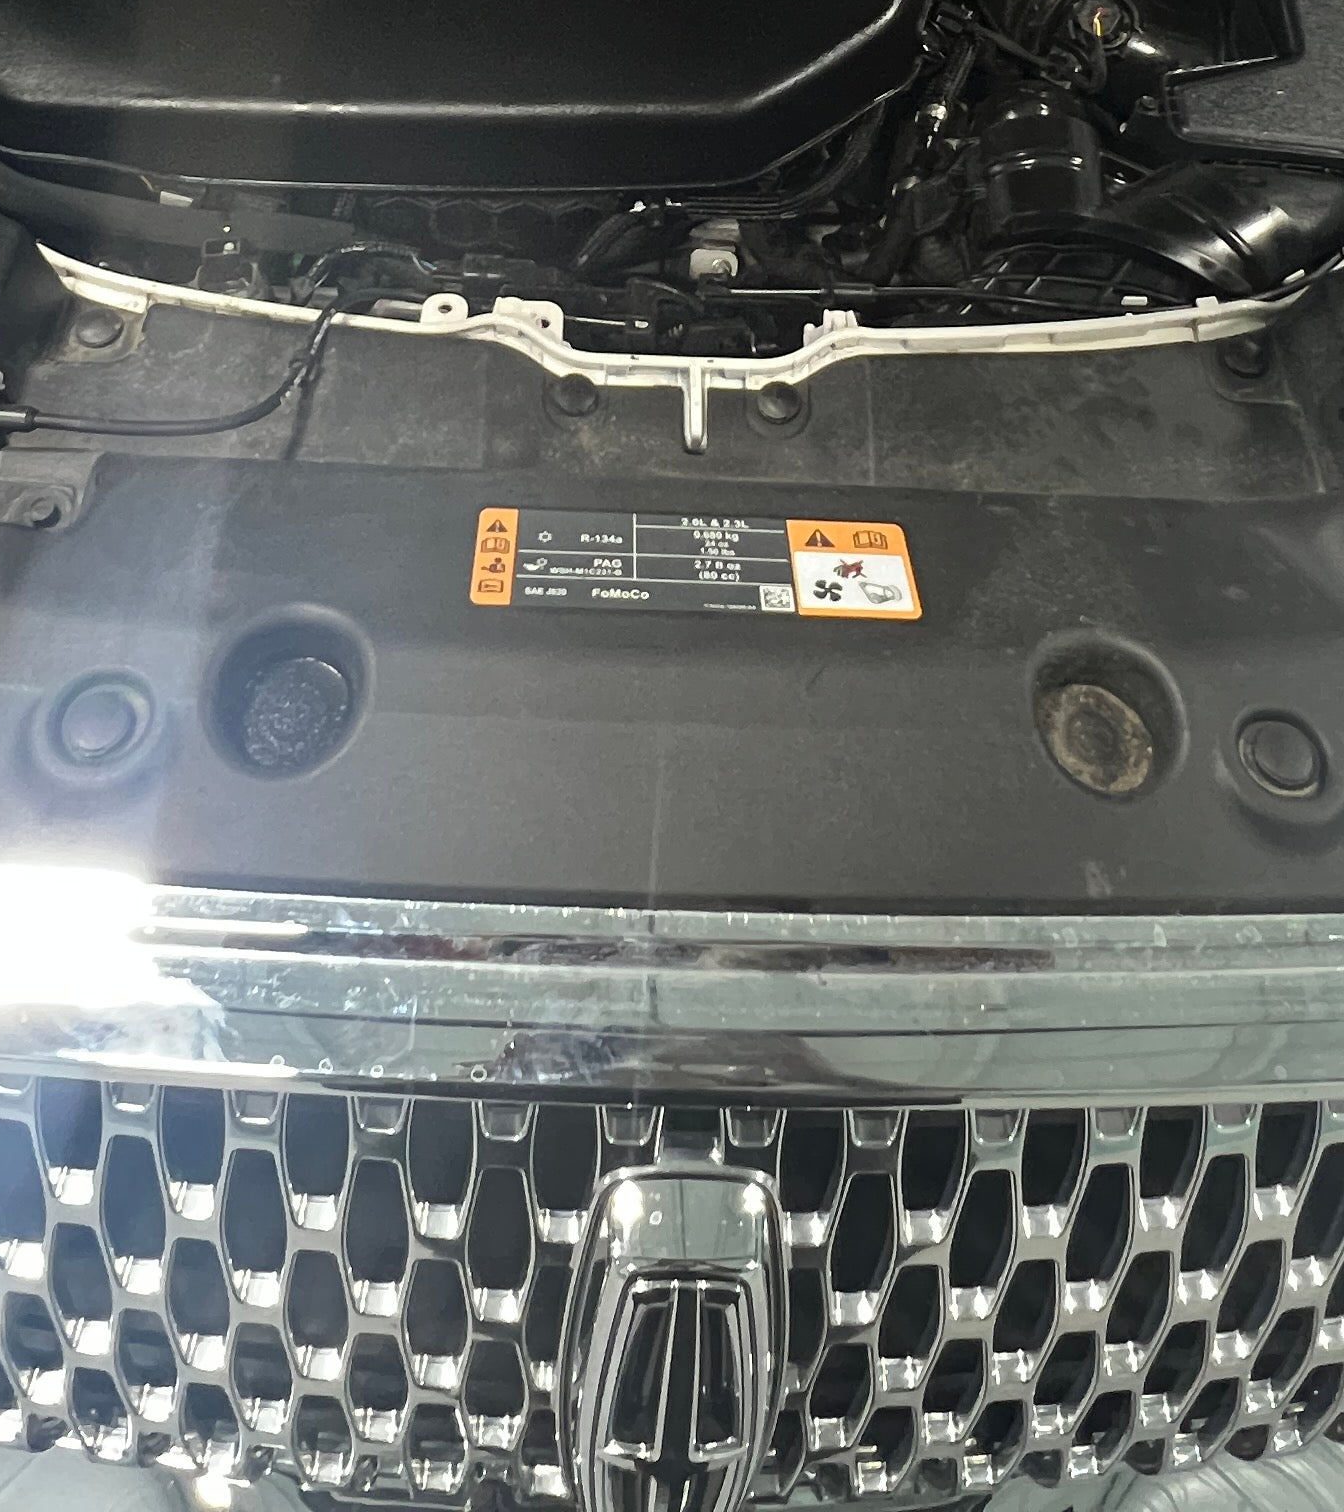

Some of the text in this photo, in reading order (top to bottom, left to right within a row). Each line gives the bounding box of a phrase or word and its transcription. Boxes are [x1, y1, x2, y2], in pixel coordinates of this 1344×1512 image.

[723, 519, 749, 528] 2.3L
[579, 533, 623, 544] R-134a
[725, 531, 739, 542] kg
[593, 558, 623, 569] PAG
[591, 587, 651, 600] FoMoCo
